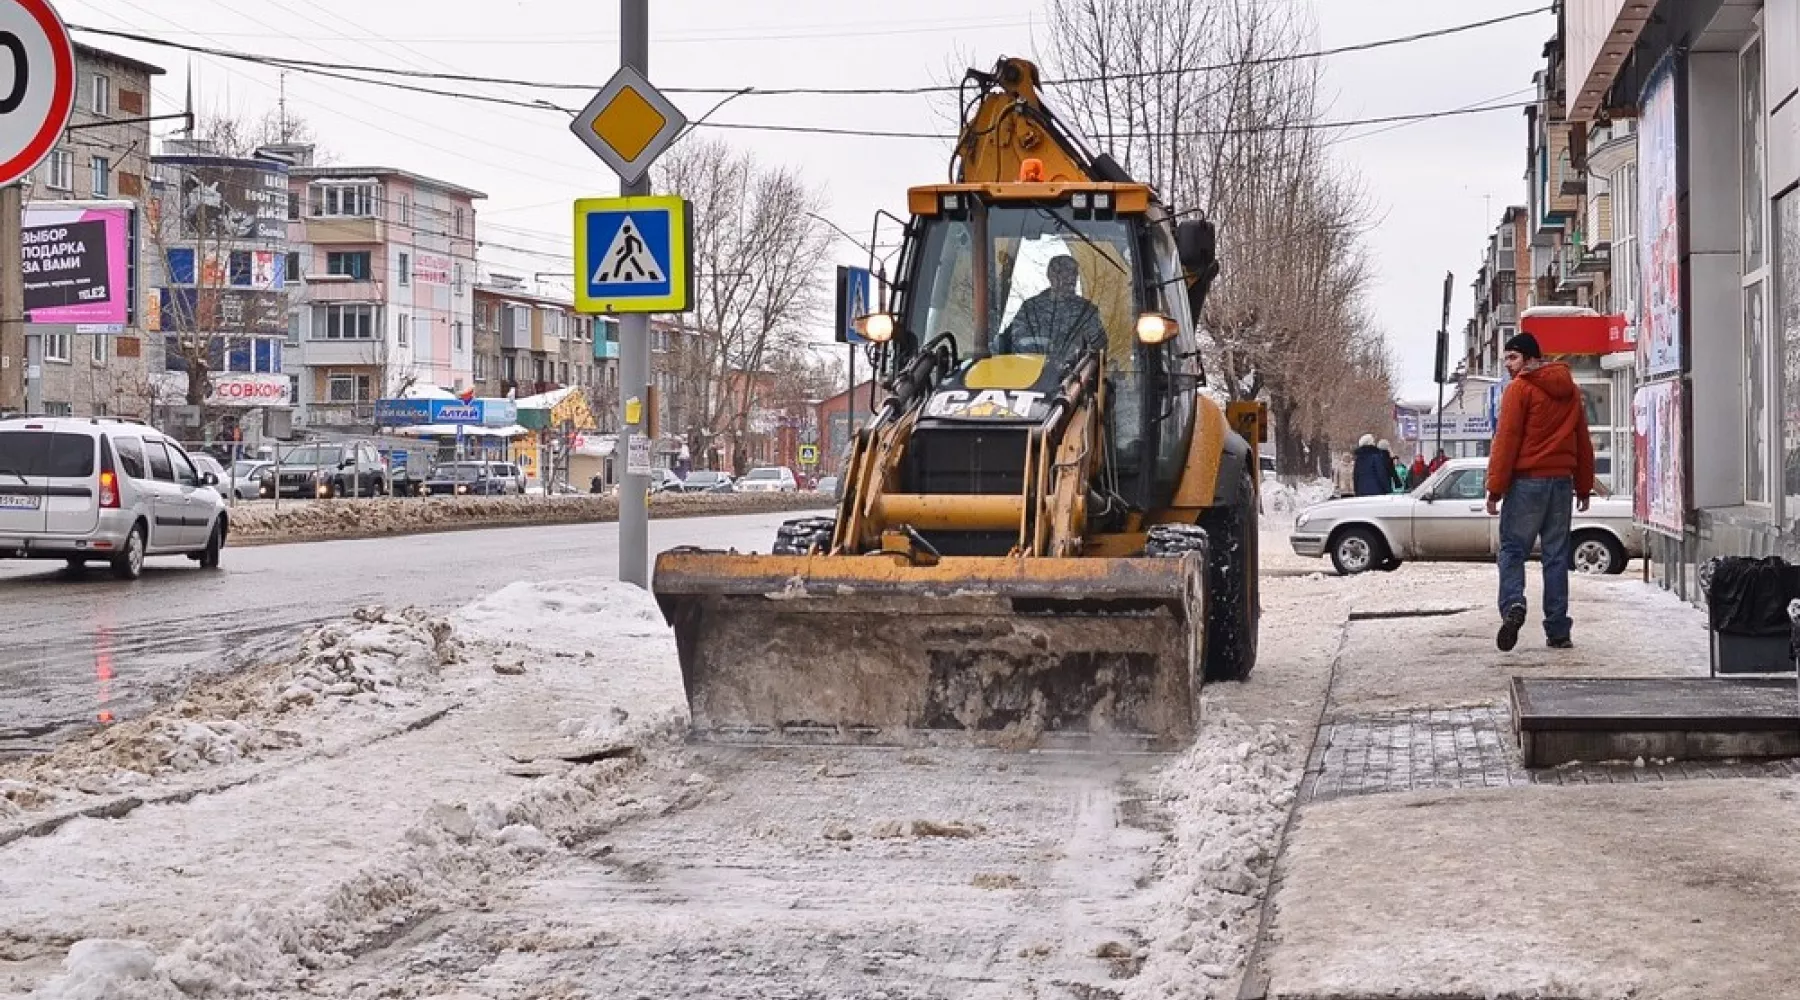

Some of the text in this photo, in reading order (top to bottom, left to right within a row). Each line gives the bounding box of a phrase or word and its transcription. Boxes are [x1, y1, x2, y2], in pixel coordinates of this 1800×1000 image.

[23, 256, 81, 273] ЗА ВАМИ
[927, 389, 1046, 417] CAT
[438, 406, 479, 419] АЛТАЙ
